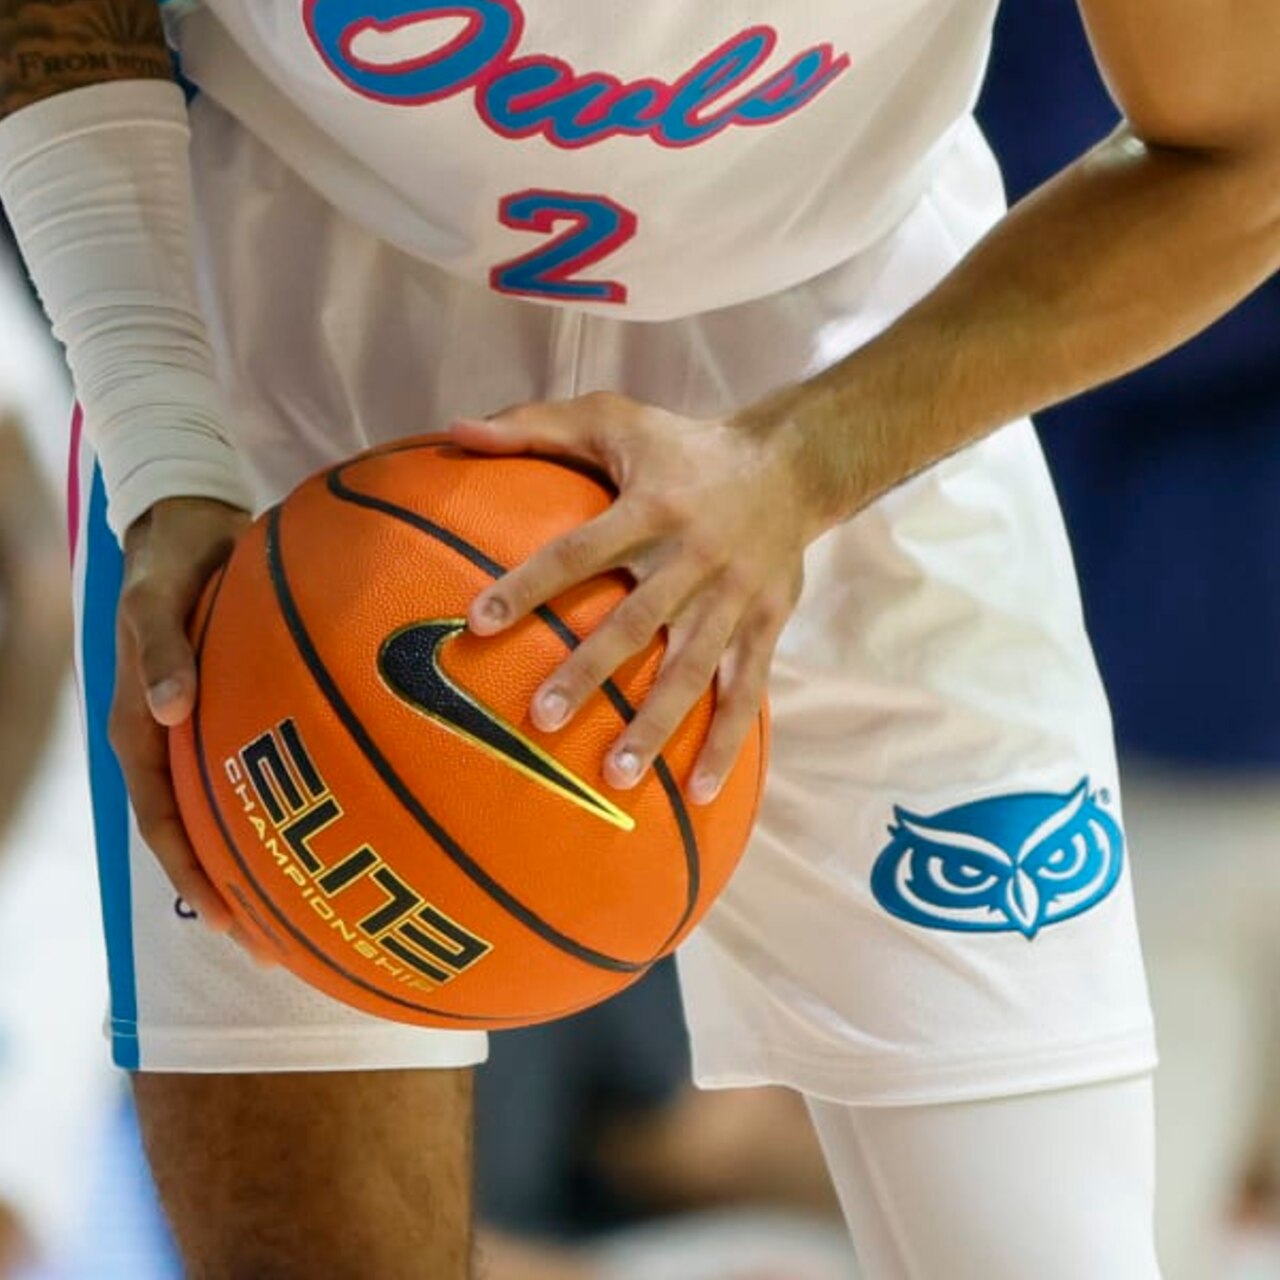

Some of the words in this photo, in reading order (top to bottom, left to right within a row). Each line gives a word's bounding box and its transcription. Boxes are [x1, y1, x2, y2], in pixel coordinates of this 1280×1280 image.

[490, 188, 638, 304] 2
[224, 757, 435, 993] CHAMPIONSHIP
[238, 716, 495, 985] ELITE
